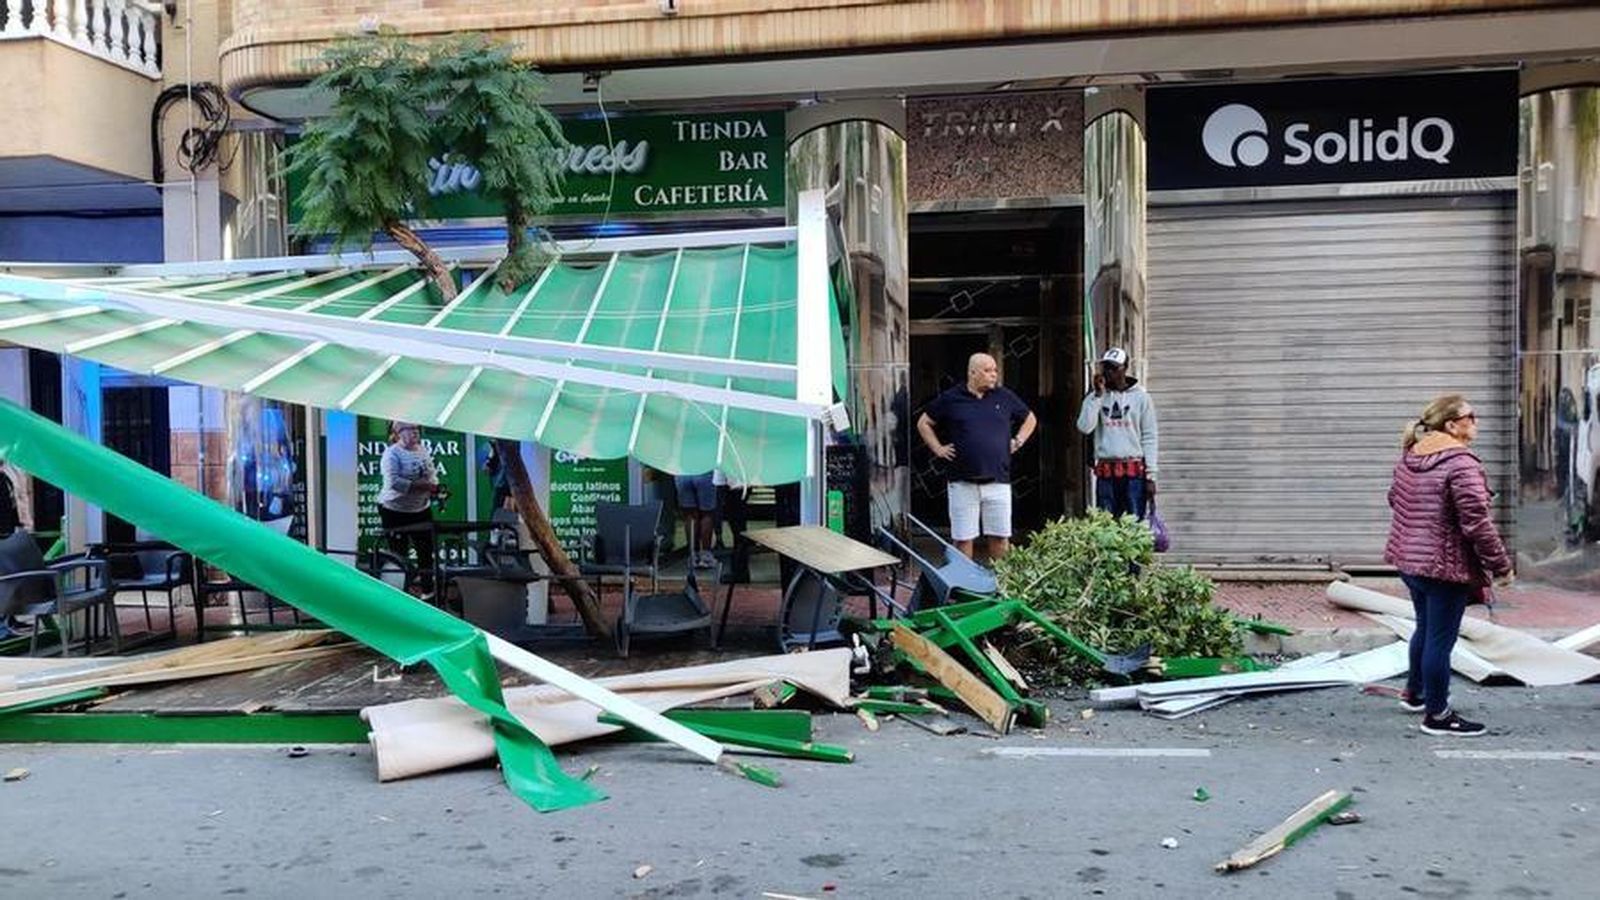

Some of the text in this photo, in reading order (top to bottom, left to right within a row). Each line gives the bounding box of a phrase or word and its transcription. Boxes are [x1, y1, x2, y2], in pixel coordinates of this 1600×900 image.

[672, 119, 768, 143] TIENDA
[1283, 116, 1456, 167] SolidQ
[718, 149, 769, 173] BAR
[634, 181, 769, 208] CAFETERÍA
[550, 481, 584, 492] ductos
